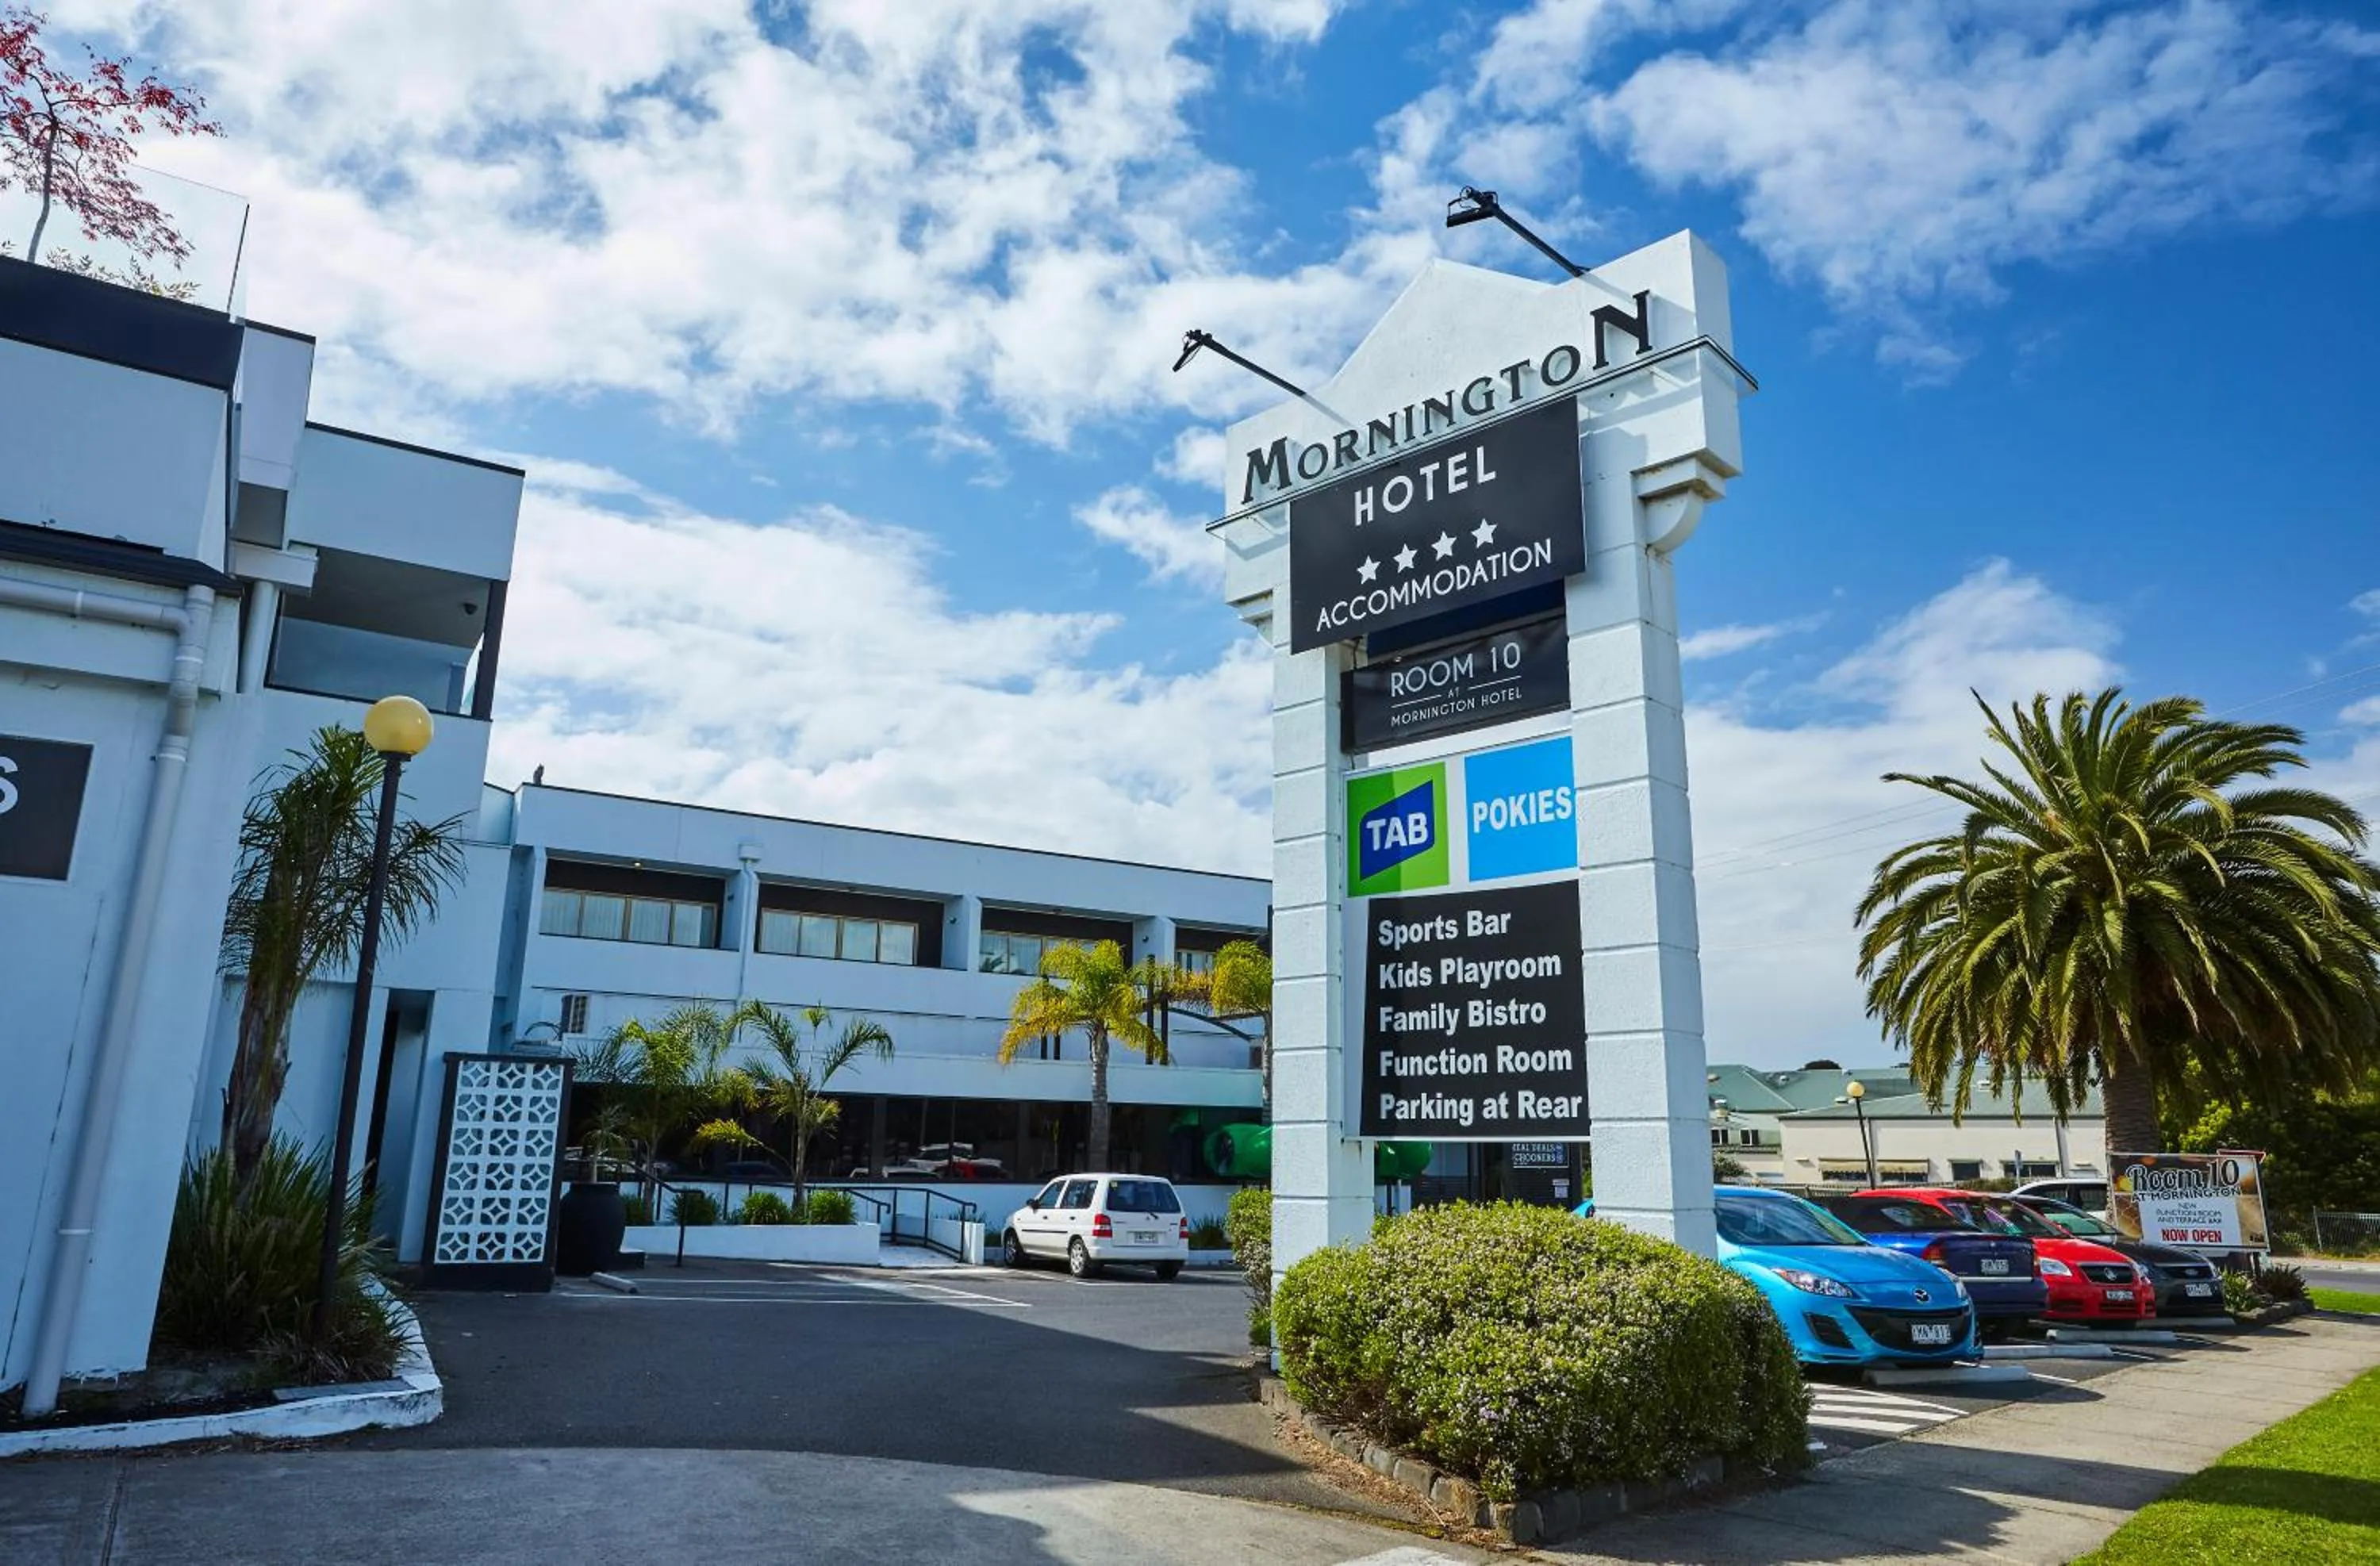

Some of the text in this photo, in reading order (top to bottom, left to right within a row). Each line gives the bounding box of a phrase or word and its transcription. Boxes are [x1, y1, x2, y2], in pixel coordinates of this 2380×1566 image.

[1242, 290, 1652, 503] MORNINGTON
[1354, 446, 1496, 526] HOTEL
[1316, 539, 1551, 632] ACCOMMODATION
[1391, 642, 1521, 697] ROOM 10
[1391, 687, 1522, 727] MORNINGTON HOTEL
[1448, 687, 1460, 699] AT
[1472, 786, 1572, 833] POKIES
[1366, 812, 1429, 851] TAB
[1378, 909, 1511, 950] Sports Bar
[1379, 953, 1561, 990] Kids Playroom
[1379, 998, 1546, 1035] Family Bistro
[1379, 1044, 1572, 1077] Function Room
[1379, 1090, 1583, 1126] Parking at Rear
[2126, 1159, 2240, 1193] Room 10
[2131, 1185, 2242, 1203] AT MORNINGTON
[2161, 1228, 2222, 1243] NOW OPEN
